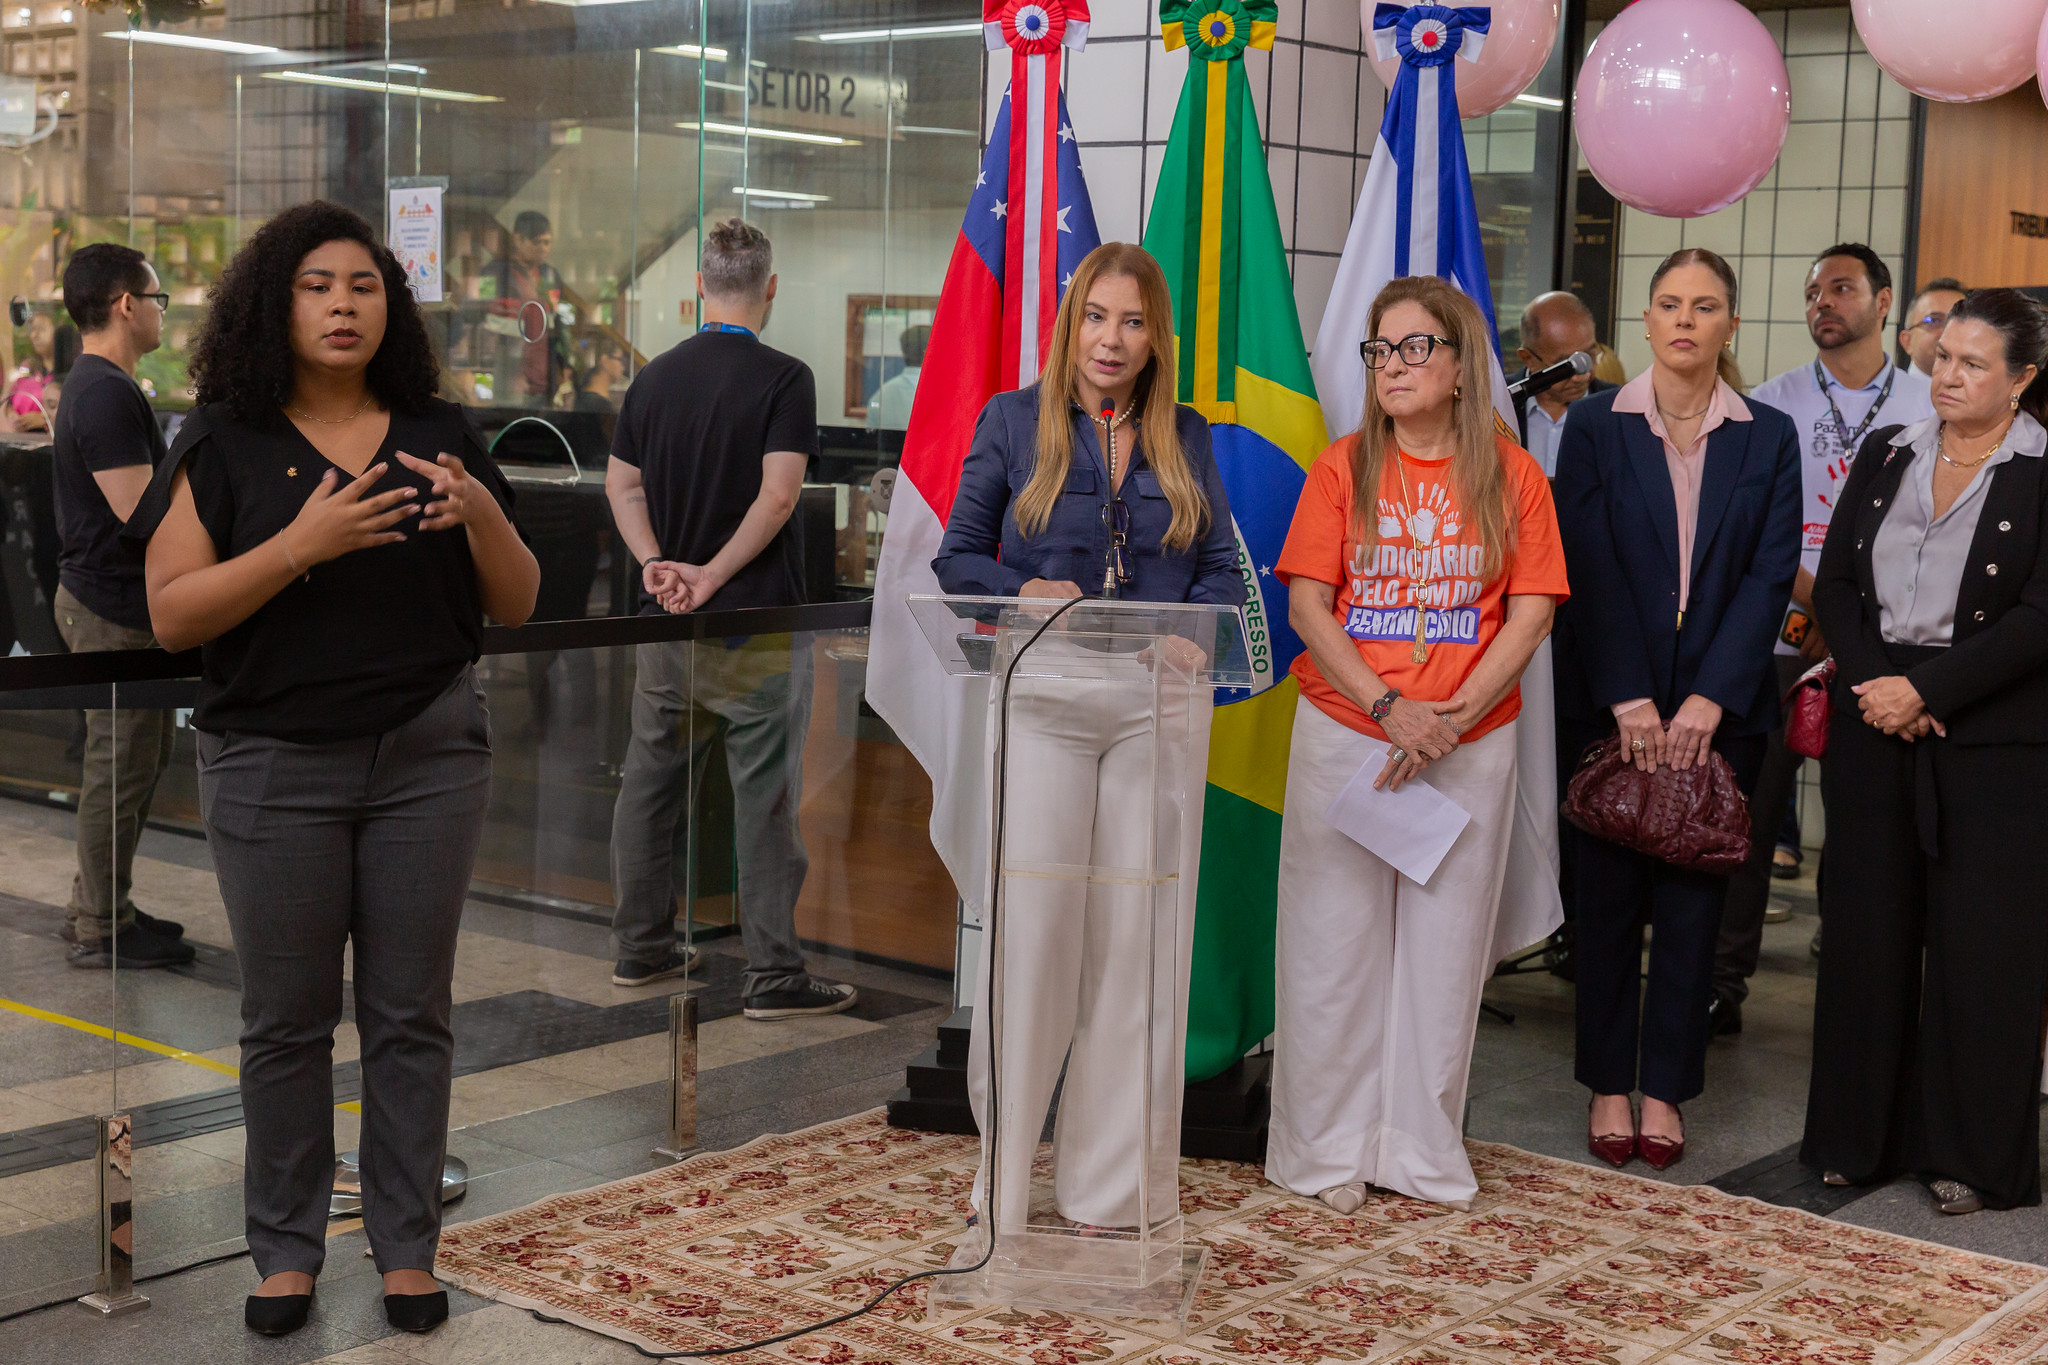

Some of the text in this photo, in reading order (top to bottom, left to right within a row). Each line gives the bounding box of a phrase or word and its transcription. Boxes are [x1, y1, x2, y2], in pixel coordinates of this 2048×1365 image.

[747, 66, 856, 118] SETOR 2
[1349, 540, 1484, 579] JUDICIÁRIO
[1350, 579, 1400, 607] PELO
[1451, 580, 1483, 607] DO
